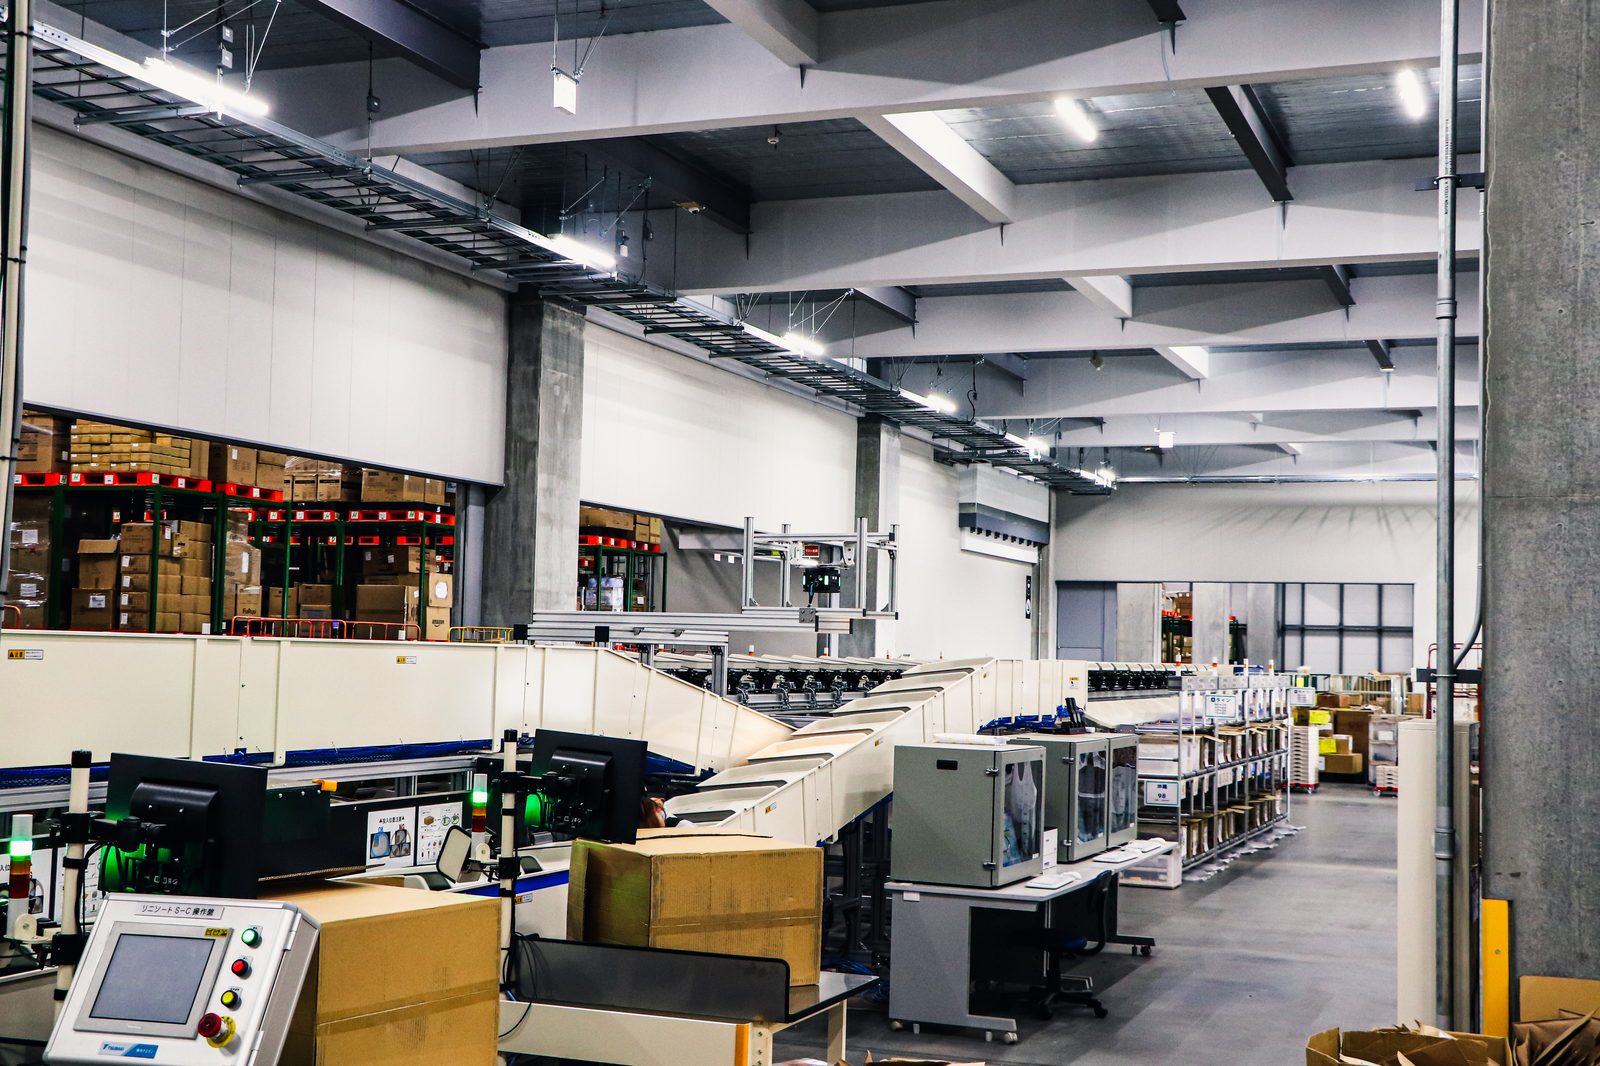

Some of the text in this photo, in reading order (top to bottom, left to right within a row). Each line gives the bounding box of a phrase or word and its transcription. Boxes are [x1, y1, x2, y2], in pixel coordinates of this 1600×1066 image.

[141, 905, 173, 914] リニソート
[192, 907, 215, 917] 操作盤
